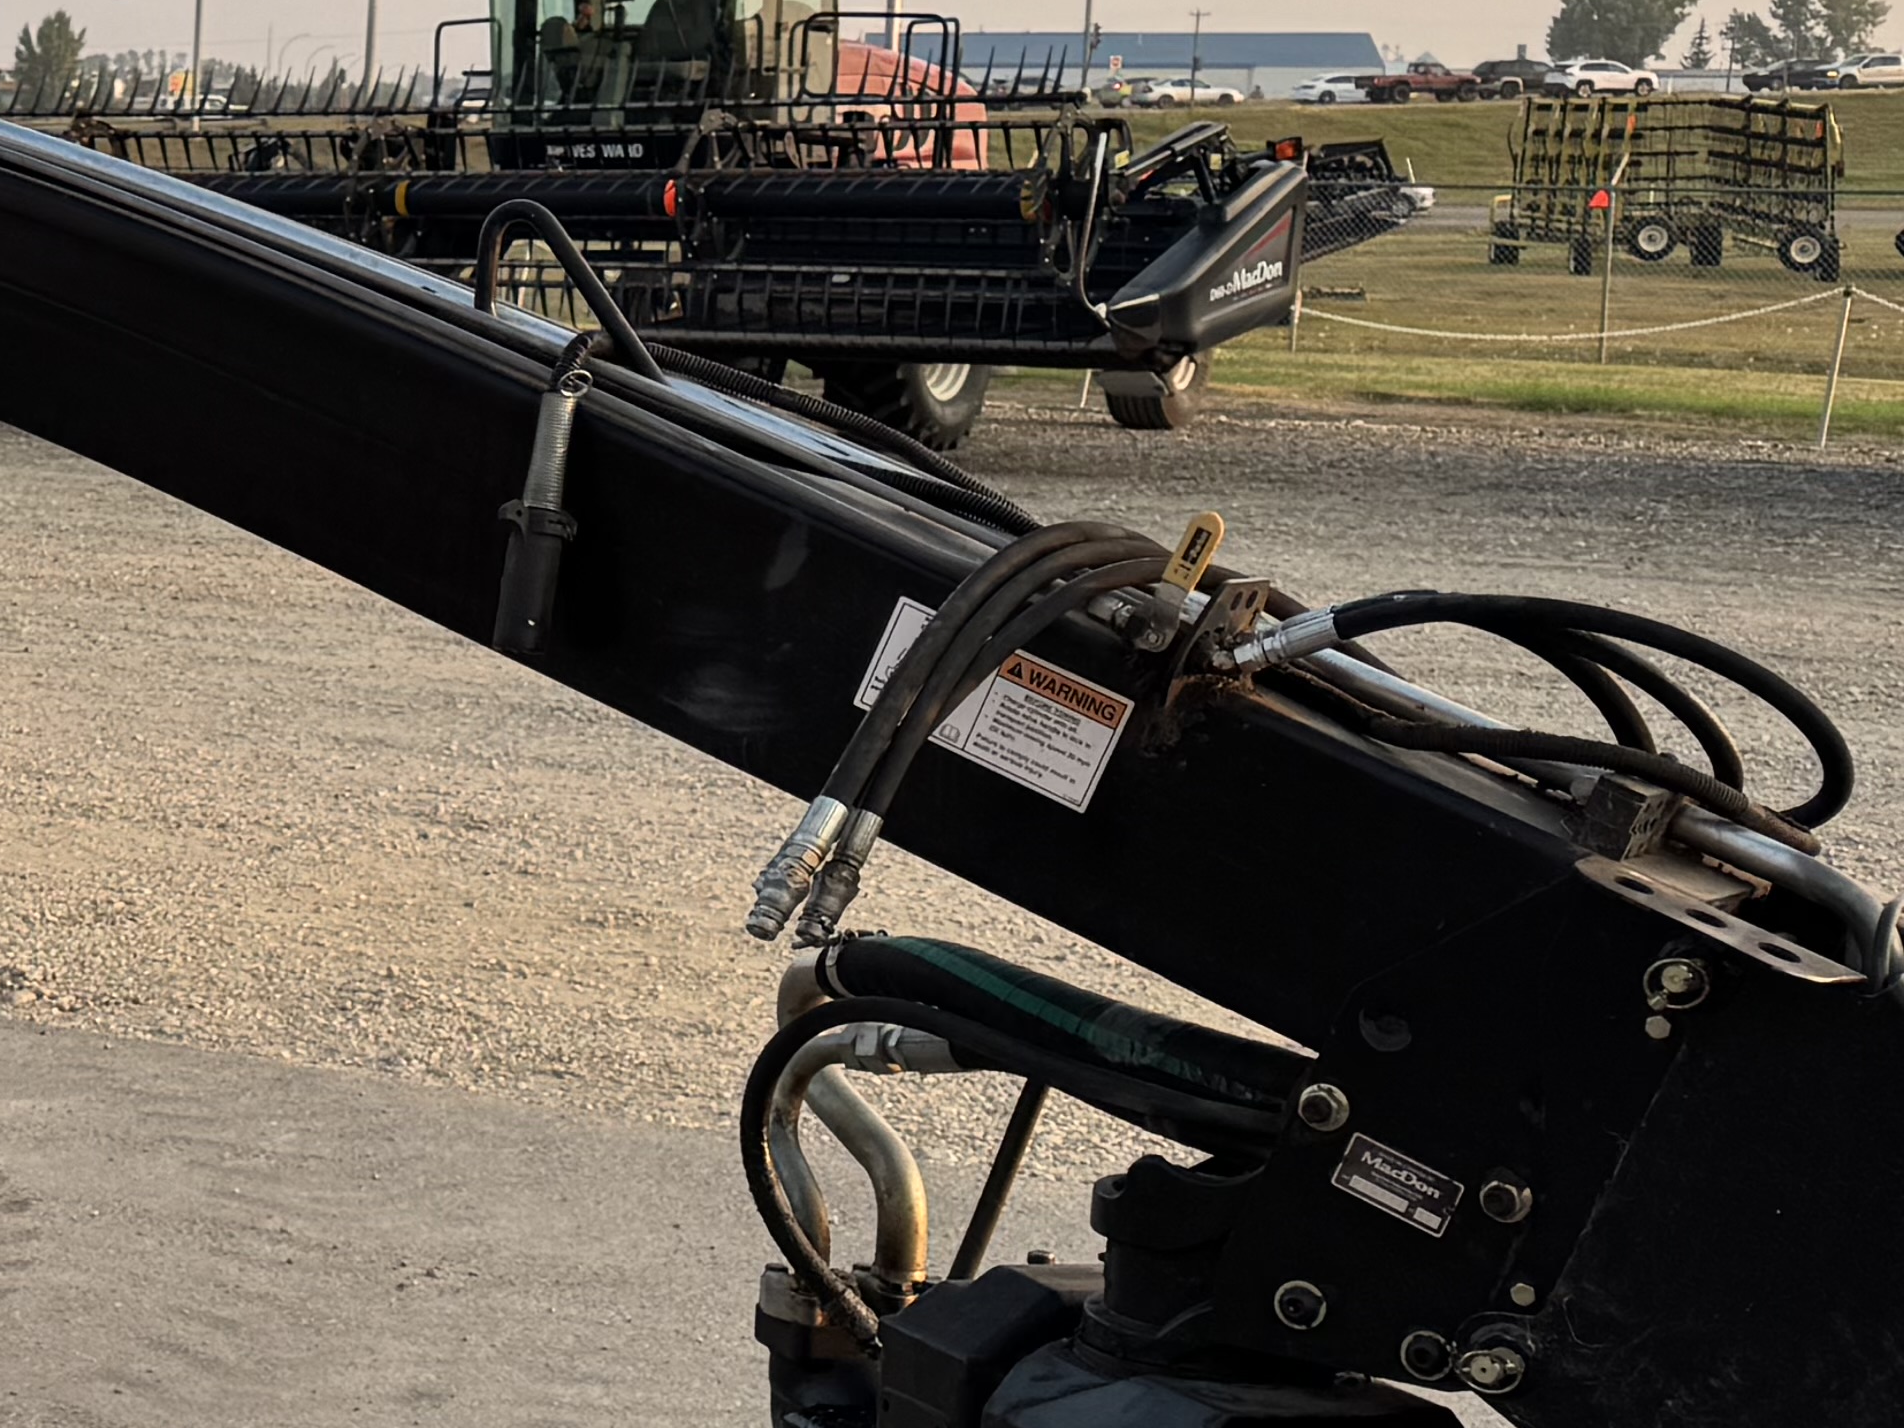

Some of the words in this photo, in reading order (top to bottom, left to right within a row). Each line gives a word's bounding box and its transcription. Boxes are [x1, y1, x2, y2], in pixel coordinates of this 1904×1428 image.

[1233, 260, 1283, 292] MacDon
[1028, 668, 1116, 722] WARNING
[1361, 1151, 1440, 1199] MacDon
